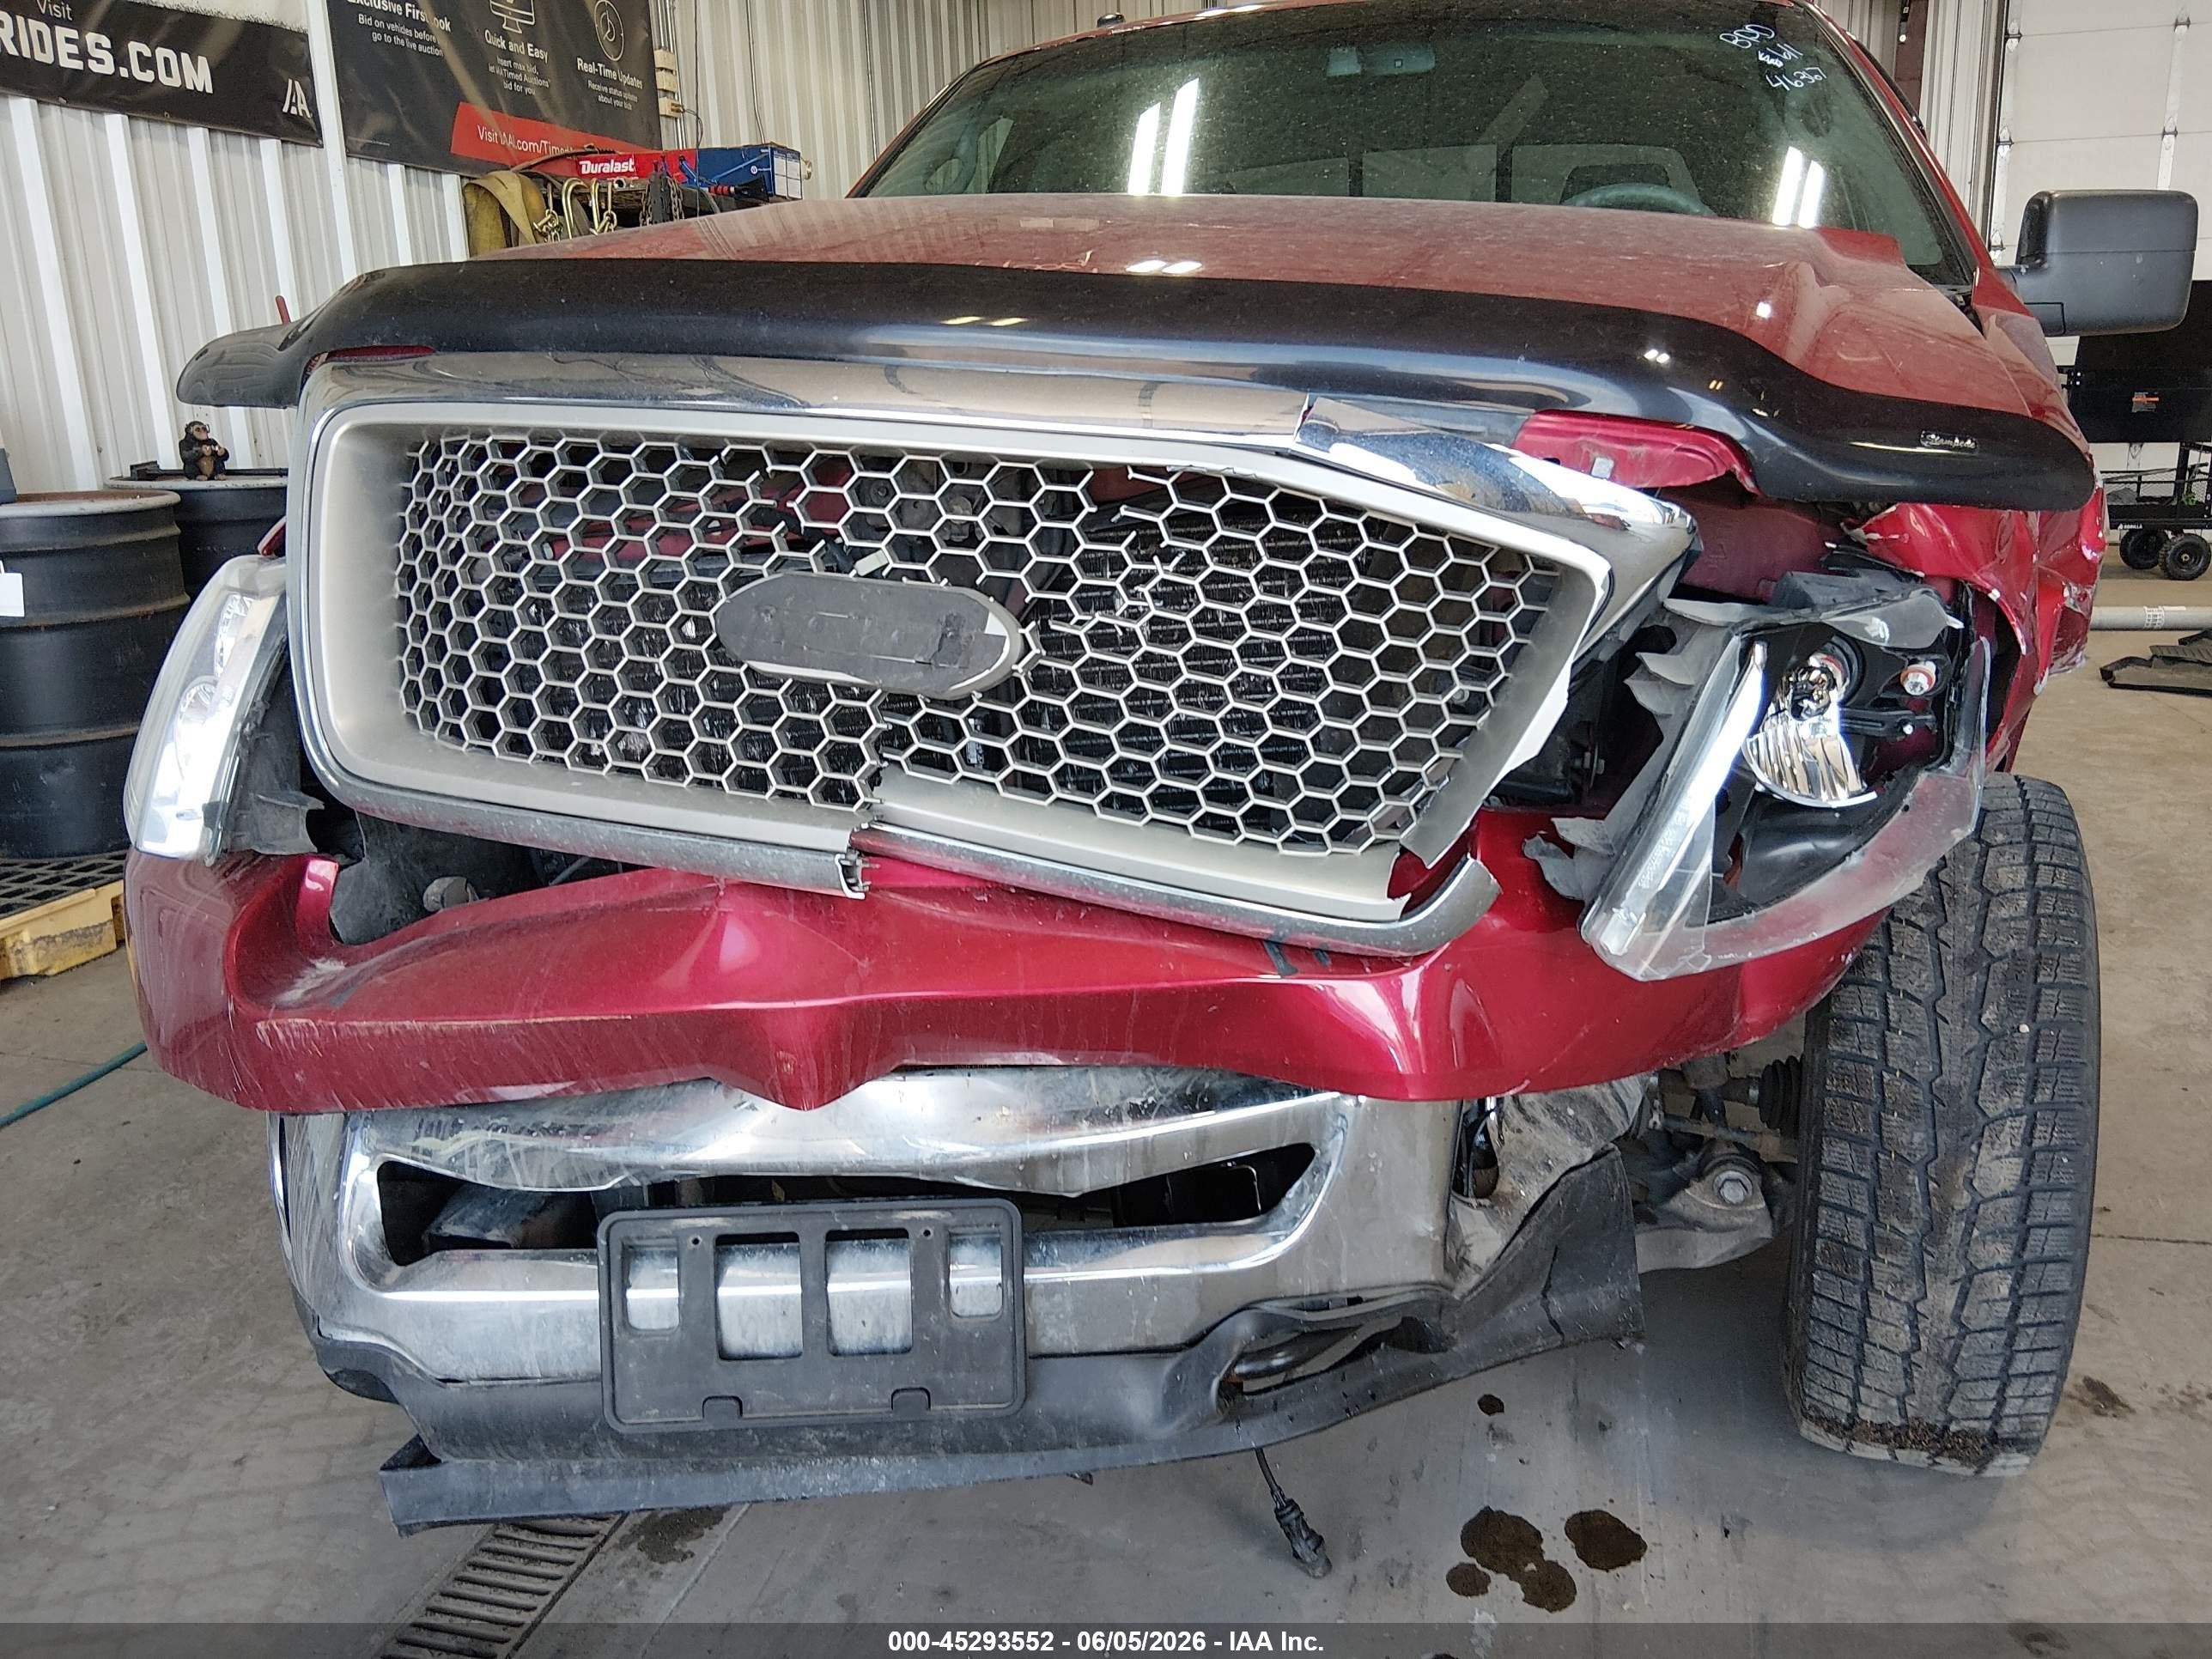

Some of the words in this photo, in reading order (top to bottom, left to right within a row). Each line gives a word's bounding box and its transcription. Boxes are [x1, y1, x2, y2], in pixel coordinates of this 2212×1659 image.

[36, 0, 73, 21] Visit
[358, 14, 373, 26] Bid
[374, 20, 385, 29] on
[386, 22, 412, 37] vehicles
[414, 28, 436, 44] before
[372, 32, 383, 42] go
[384, 33, 392, 44] to
[393, 35, 405, 46] the
[405, 39, 417, 51] live
[418, 44, 444, 57] auction
[484, 29, 507, 50] Quick
[508, 41, 526, 56] and
[527, 43, 549, 64] Easy
[576, 57, 617, 80] Real-Time
[617, 70, 643, 90] Updates
[477, 125, 498, 144] Visit
[579, 158, 635, 175] Duralast
